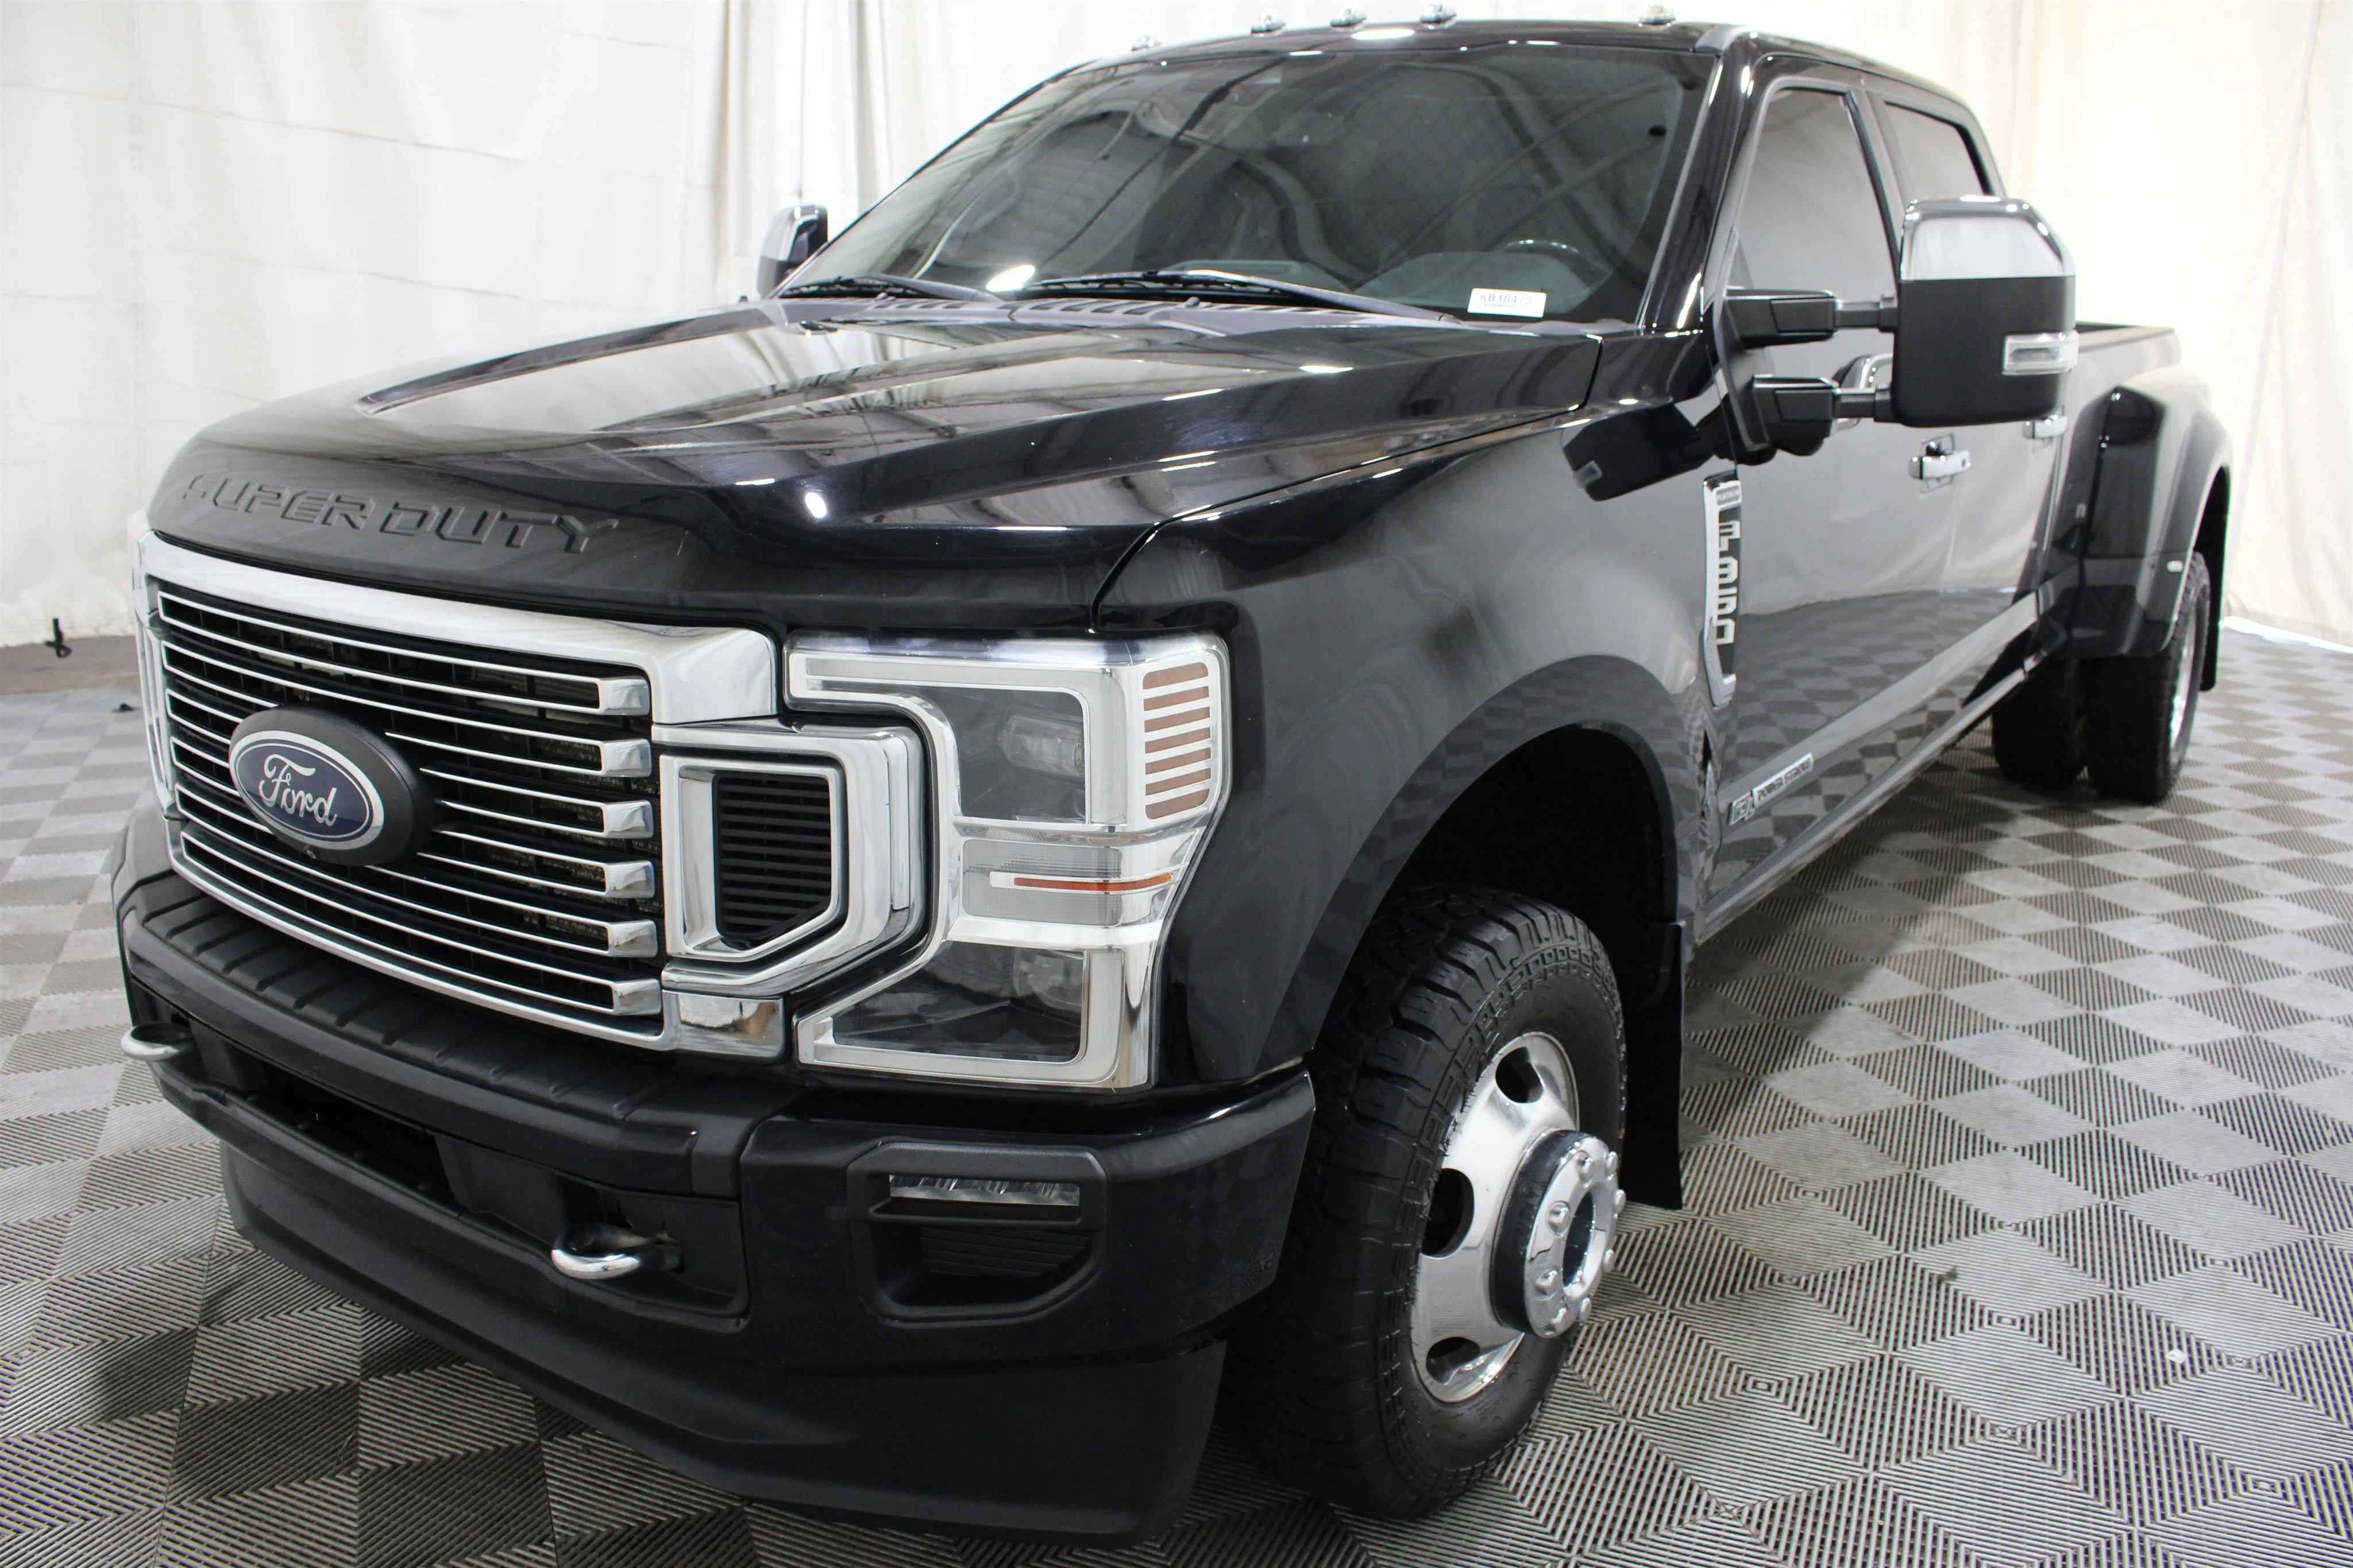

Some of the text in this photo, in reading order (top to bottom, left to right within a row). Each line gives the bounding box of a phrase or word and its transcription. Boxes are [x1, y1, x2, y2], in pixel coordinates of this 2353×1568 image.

[183, 473, 619, 554] SUPER DUTY
[259, 753, 338, 827] Ford
